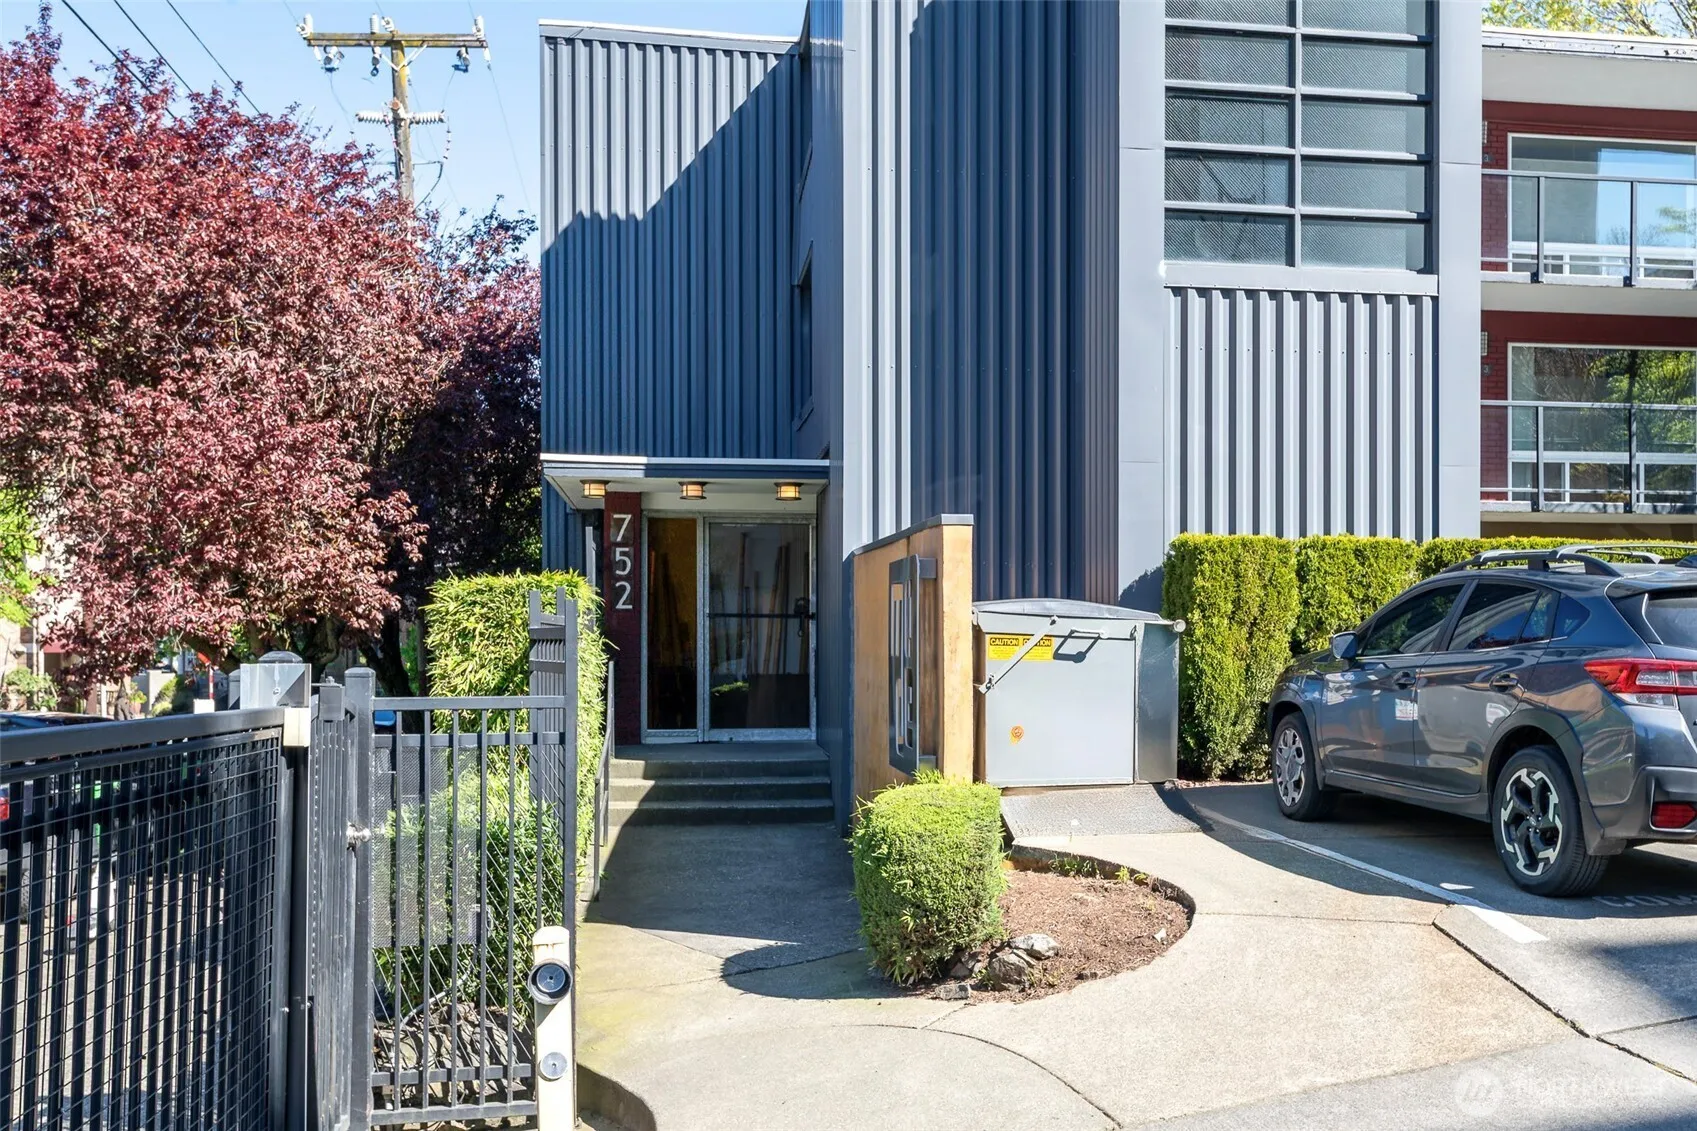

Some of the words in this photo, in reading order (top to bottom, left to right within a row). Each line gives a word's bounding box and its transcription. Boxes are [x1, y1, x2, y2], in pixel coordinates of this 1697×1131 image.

[612, 513, 633, 610] 752
[990, 638, 1019, 646] CAUTION
[1023, 638, 1051, 646] CION
